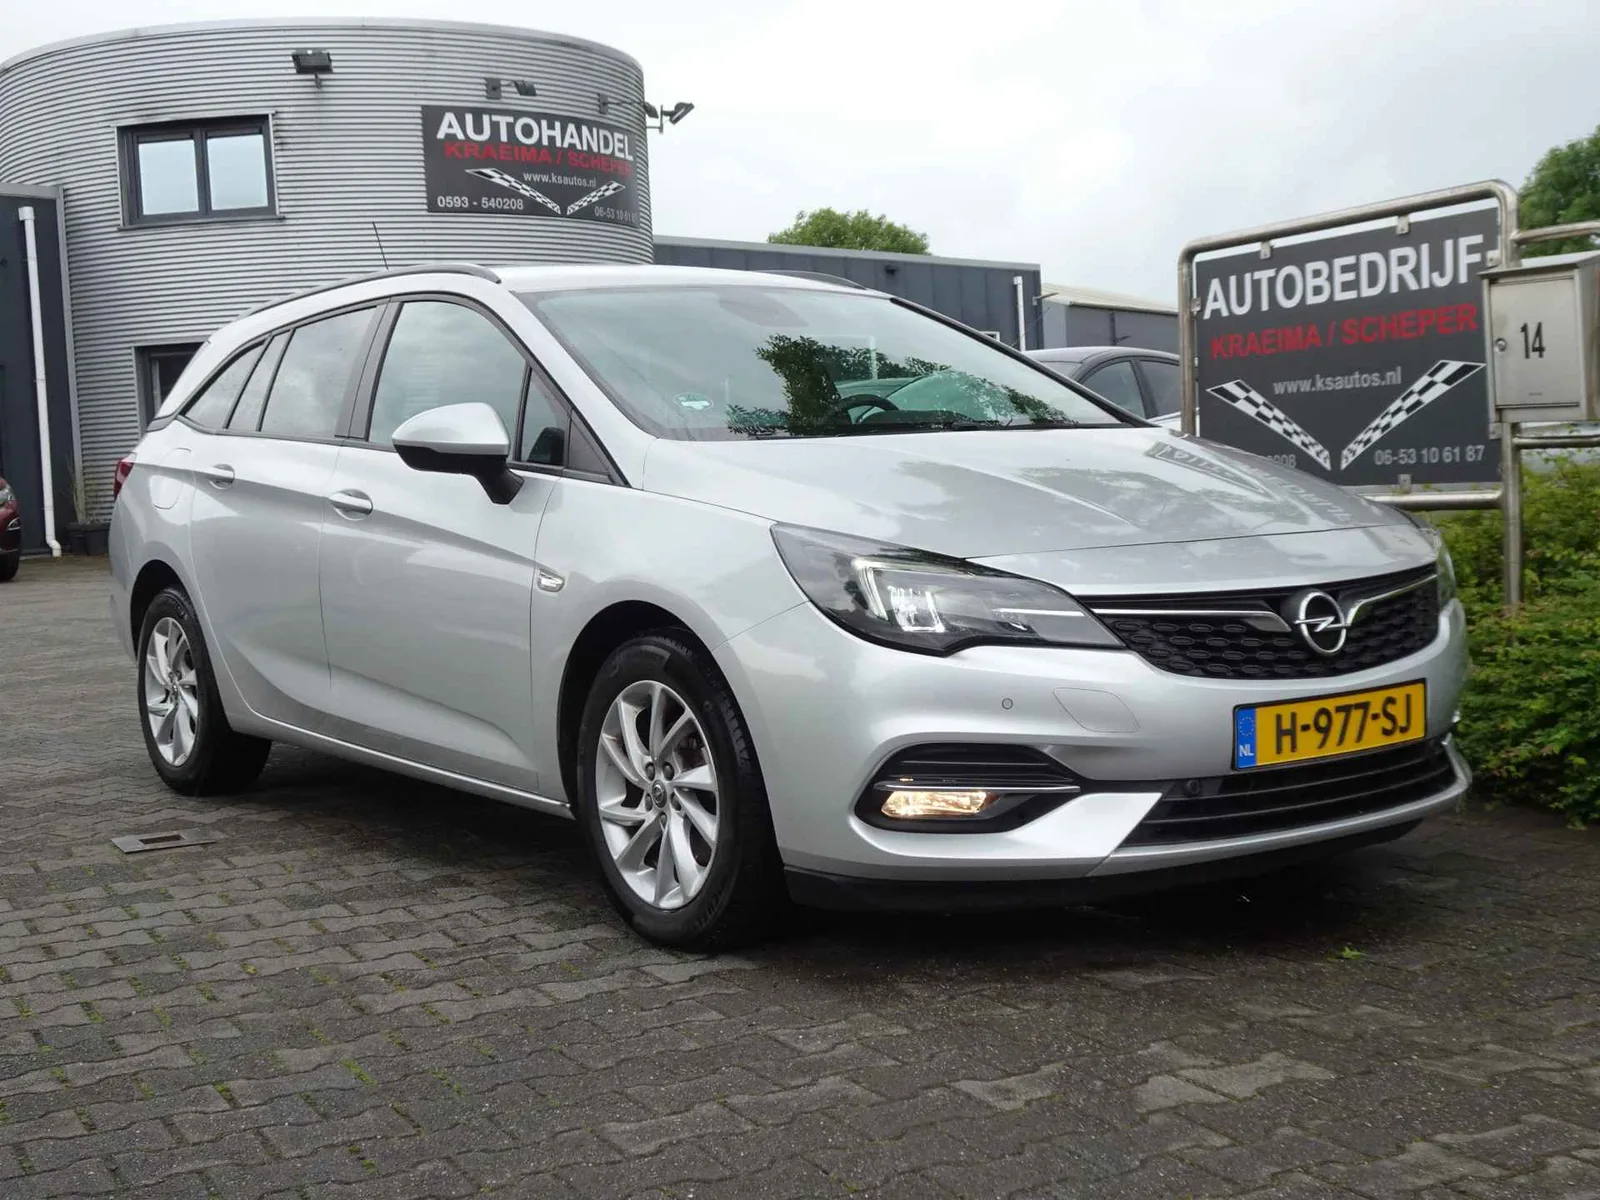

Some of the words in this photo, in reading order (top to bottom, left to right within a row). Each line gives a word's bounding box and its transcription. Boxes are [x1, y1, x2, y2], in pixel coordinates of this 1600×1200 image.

[436, 111, 634, 161] AUTOHANDEL
[443, 140, 552, 165] KRAEIMA
[567, 149, 632, 177] SCHEPER
[523, 172, 597, 188] www.ksautos.nl
[437, 195, 469, 209] 0593
[481, 196, 524, 211] 540208
[1203, 234, 1485, 320] AUTOBEDRIJF
[1210, 322, 1321, 360] KRAEIMA
[1326, 319, 1336, 347] /
[1341, 302, 1478, 346] SCHEPER
[1520, 321, 1546, 360] 14
[1273, 366, 1403, 396] www.ksautos.nl
[1374, 448, 1418, 465] 06-53
[1420, 447, 1440, 464] 10
[1442, 446, 1461, 463] 61
[1465, 444, 1486, 462] 87
[1275, 693, 1412, 755] H-977-SJ
[1239, 743, 1255, 758] NL
